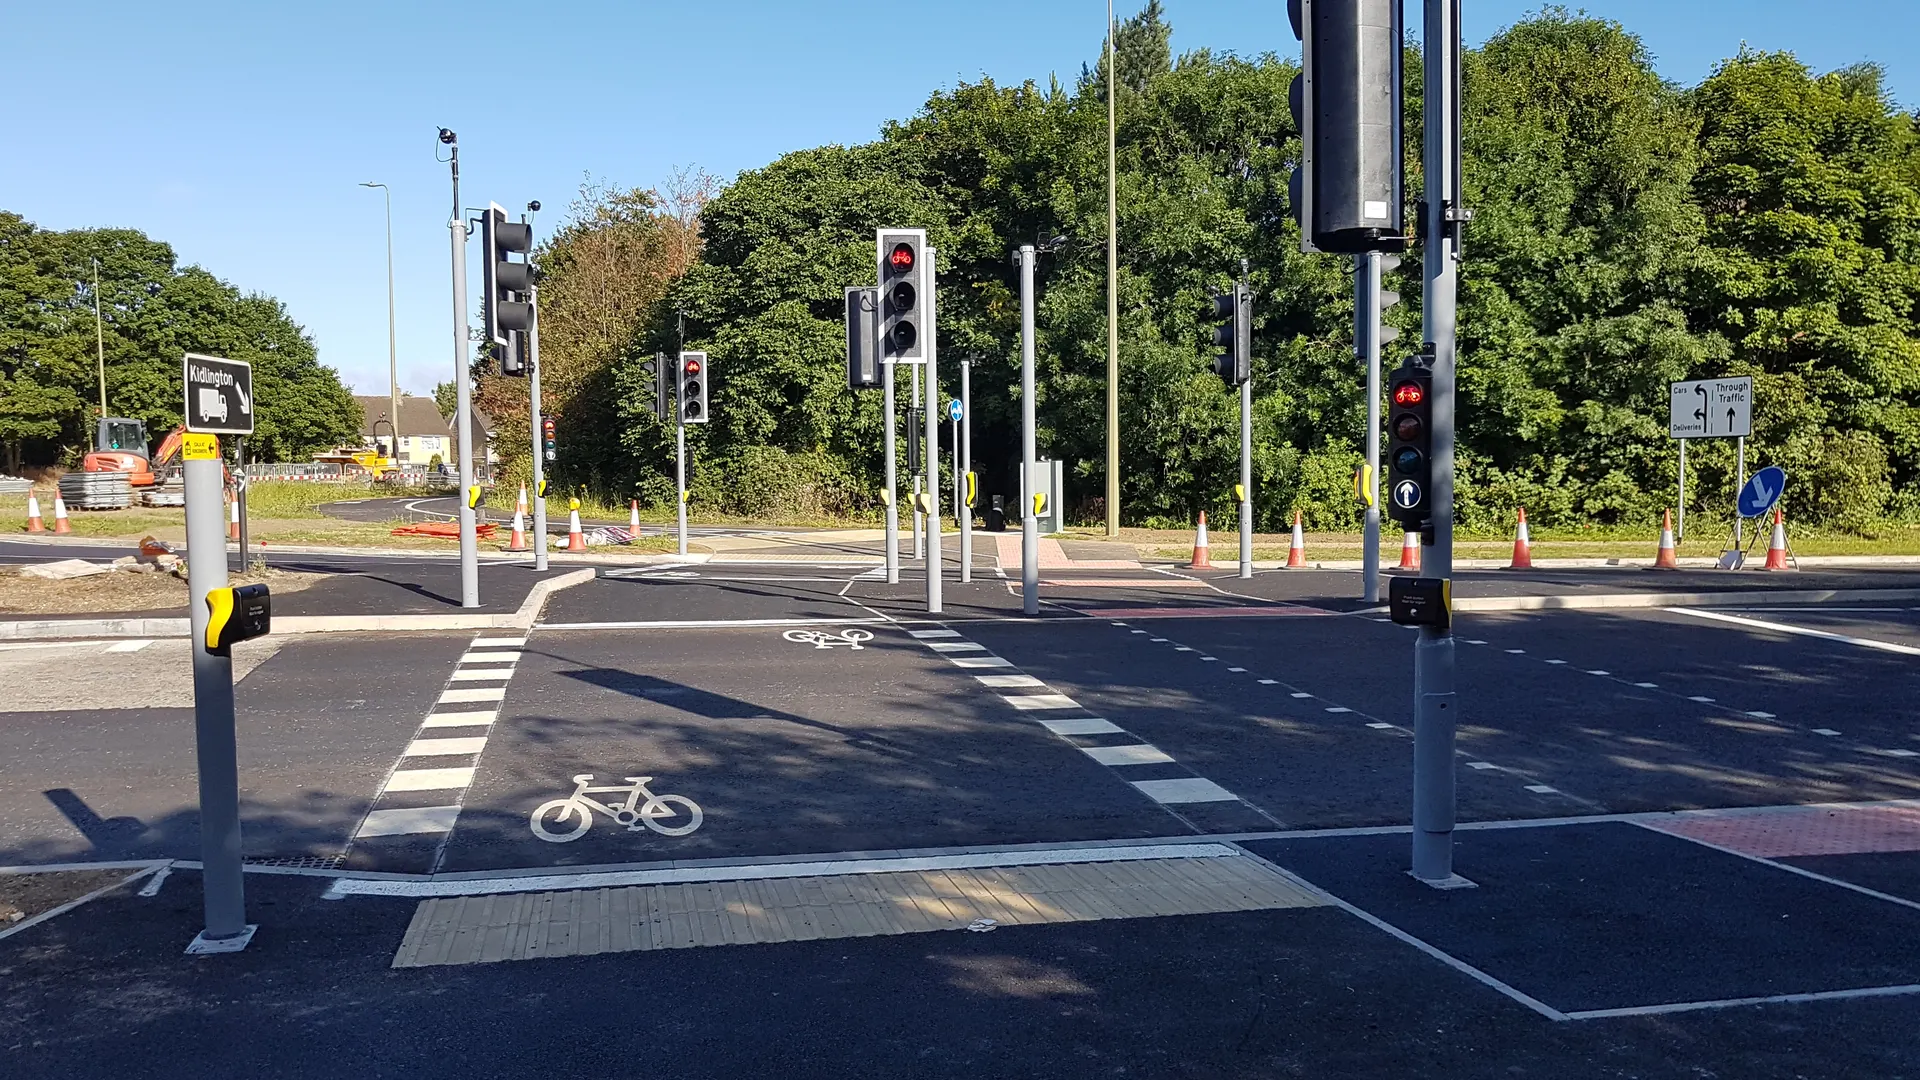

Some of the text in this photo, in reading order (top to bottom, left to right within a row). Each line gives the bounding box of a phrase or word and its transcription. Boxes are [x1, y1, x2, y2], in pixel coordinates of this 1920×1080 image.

[190, 364, 234, 388] Kidlington
[1716, 382, 1748, 393] Through
[1719, 394, 1745, 403] Traffic
[1673, 423, 1701, 431] Deliveries
